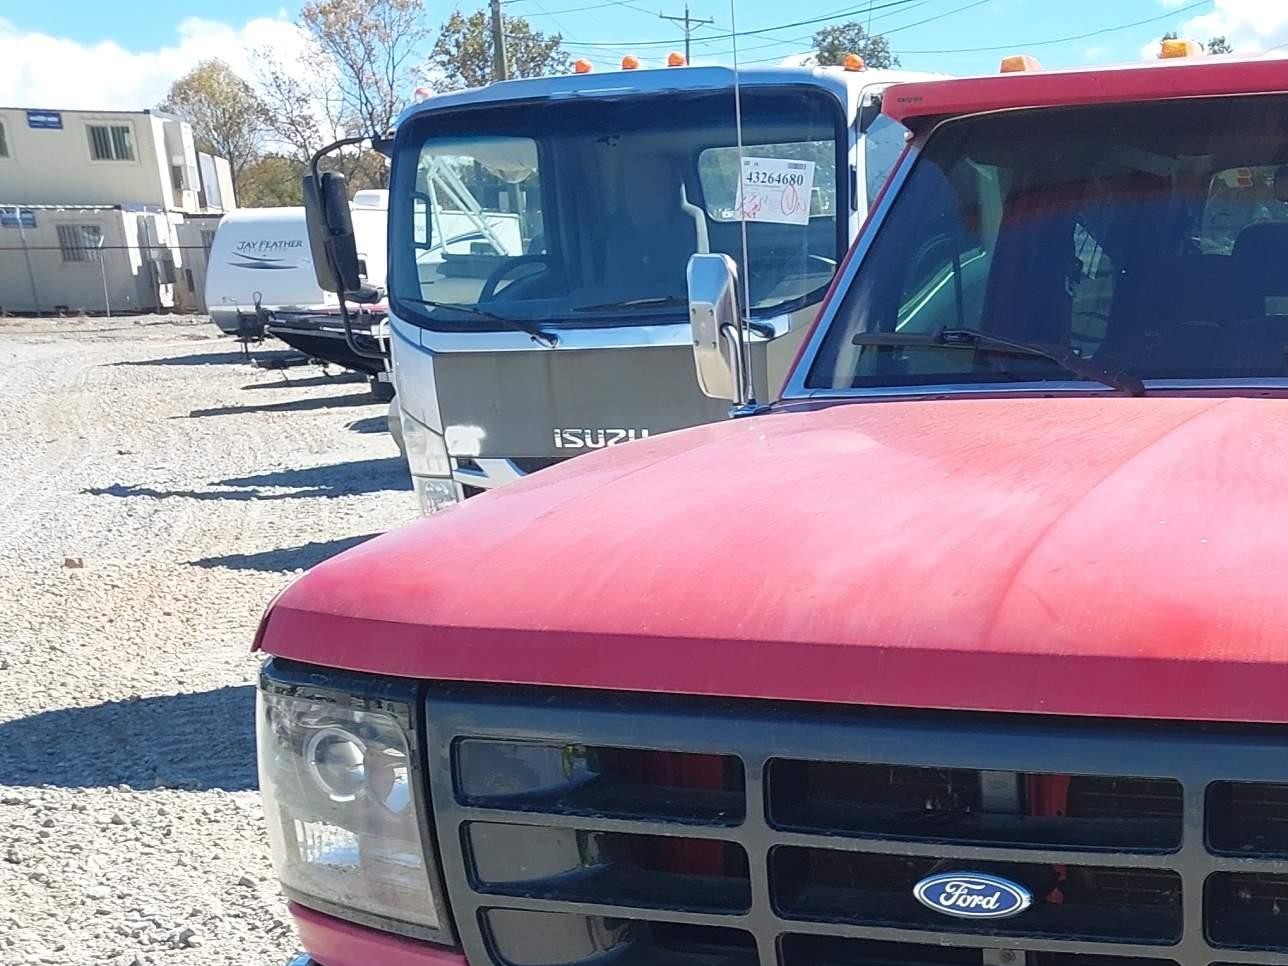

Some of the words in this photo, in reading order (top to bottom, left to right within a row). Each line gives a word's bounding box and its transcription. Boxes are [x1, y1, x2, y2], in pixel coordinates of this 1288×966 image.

[746, 171, 804, 186] 43264680
[237, 240, 258, 250] JAY
[260, 240, 304, 249] FEATHER
[939, 881, 1001, 910] Ford
